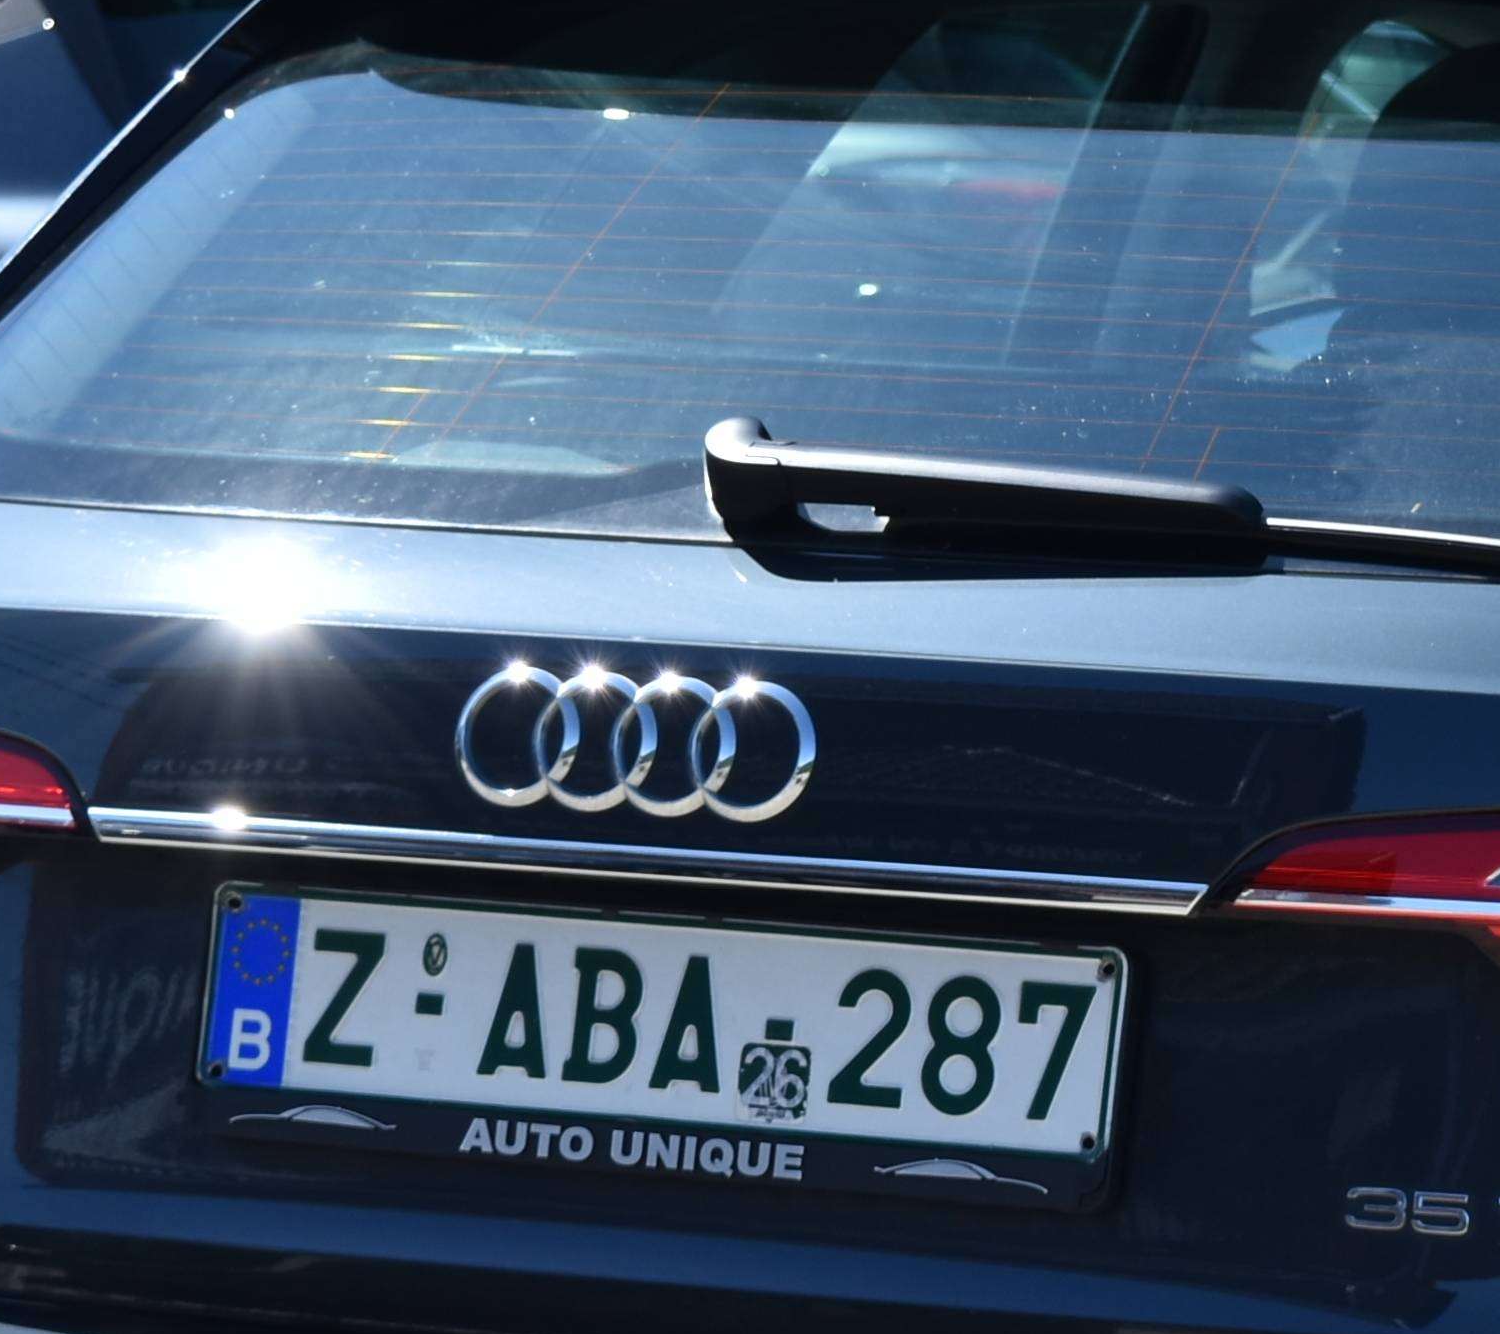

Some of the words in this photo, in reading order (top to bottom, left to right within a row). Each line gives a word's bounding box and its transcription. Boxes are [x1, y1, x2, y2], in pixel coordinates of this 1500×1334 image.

[225, 1008, 272, 1071] B
[459, 1117, 594, 1162] AUTO
[610, 1129, 805, 1181] UNIQUE
[1345, 1186, 1470, 1236] 35
